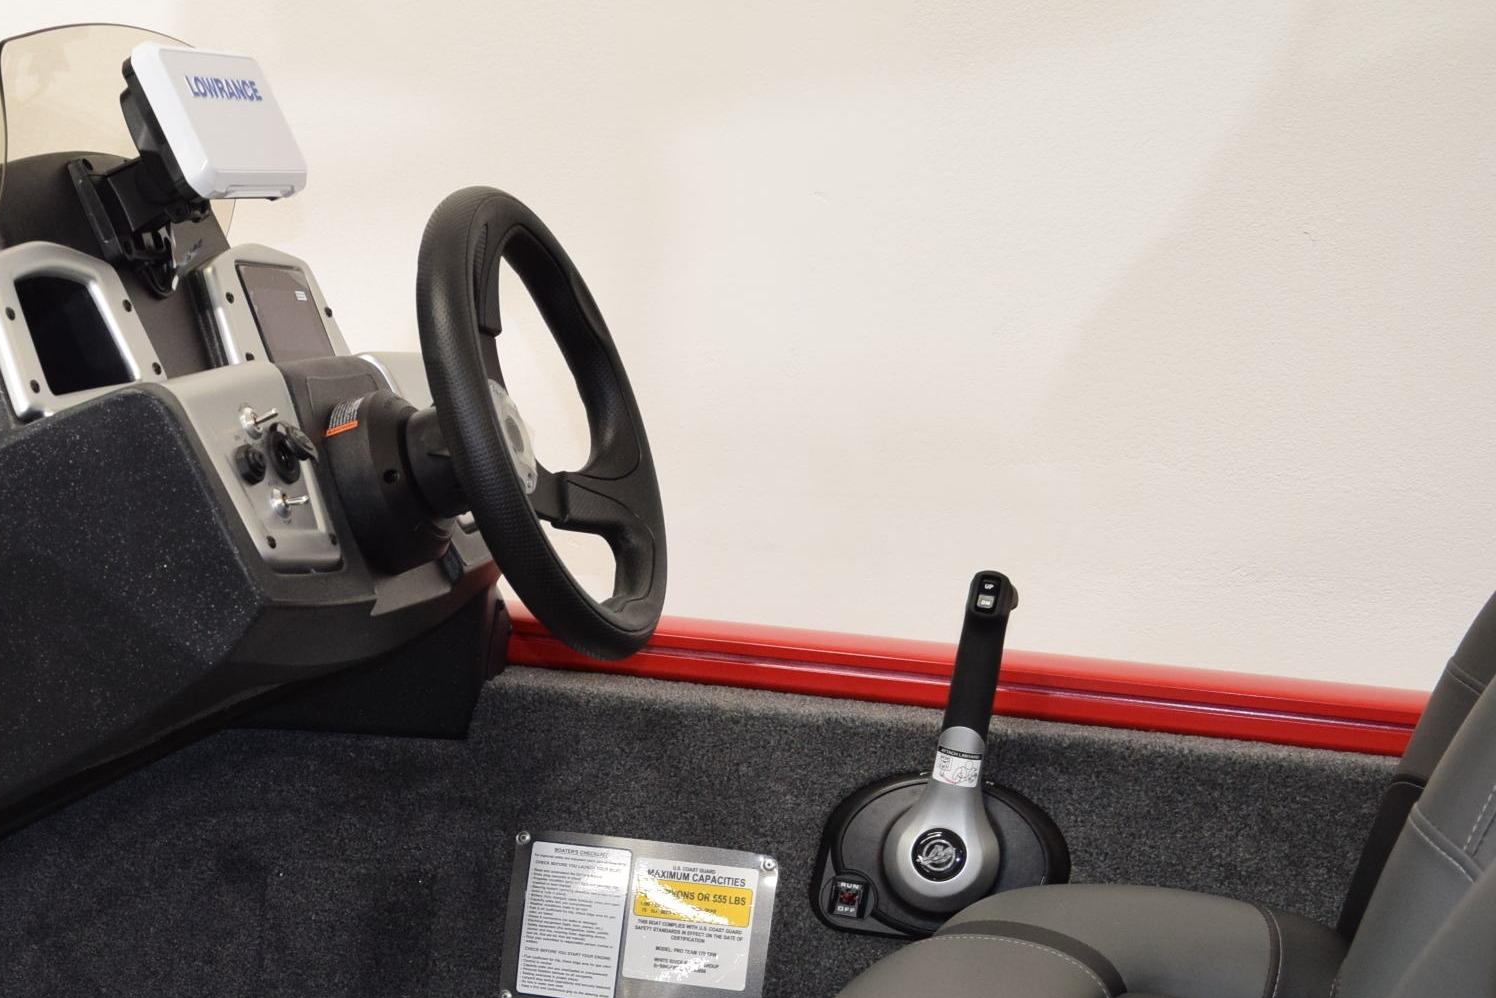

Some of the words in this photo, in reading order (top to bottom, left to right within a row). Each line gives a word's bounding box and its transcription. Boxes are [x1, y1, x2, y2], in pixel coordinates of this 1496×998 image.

[185, 75, 263, 101] LOWRANCE
[648, 869, 690, 881] MAXIMUM
[692, 873, 746, 887] CAPACITIES
[697, 892, 710, 902] OR
[712, 894, 727, 904] 555
[729, 896, 746, 906] LBS
